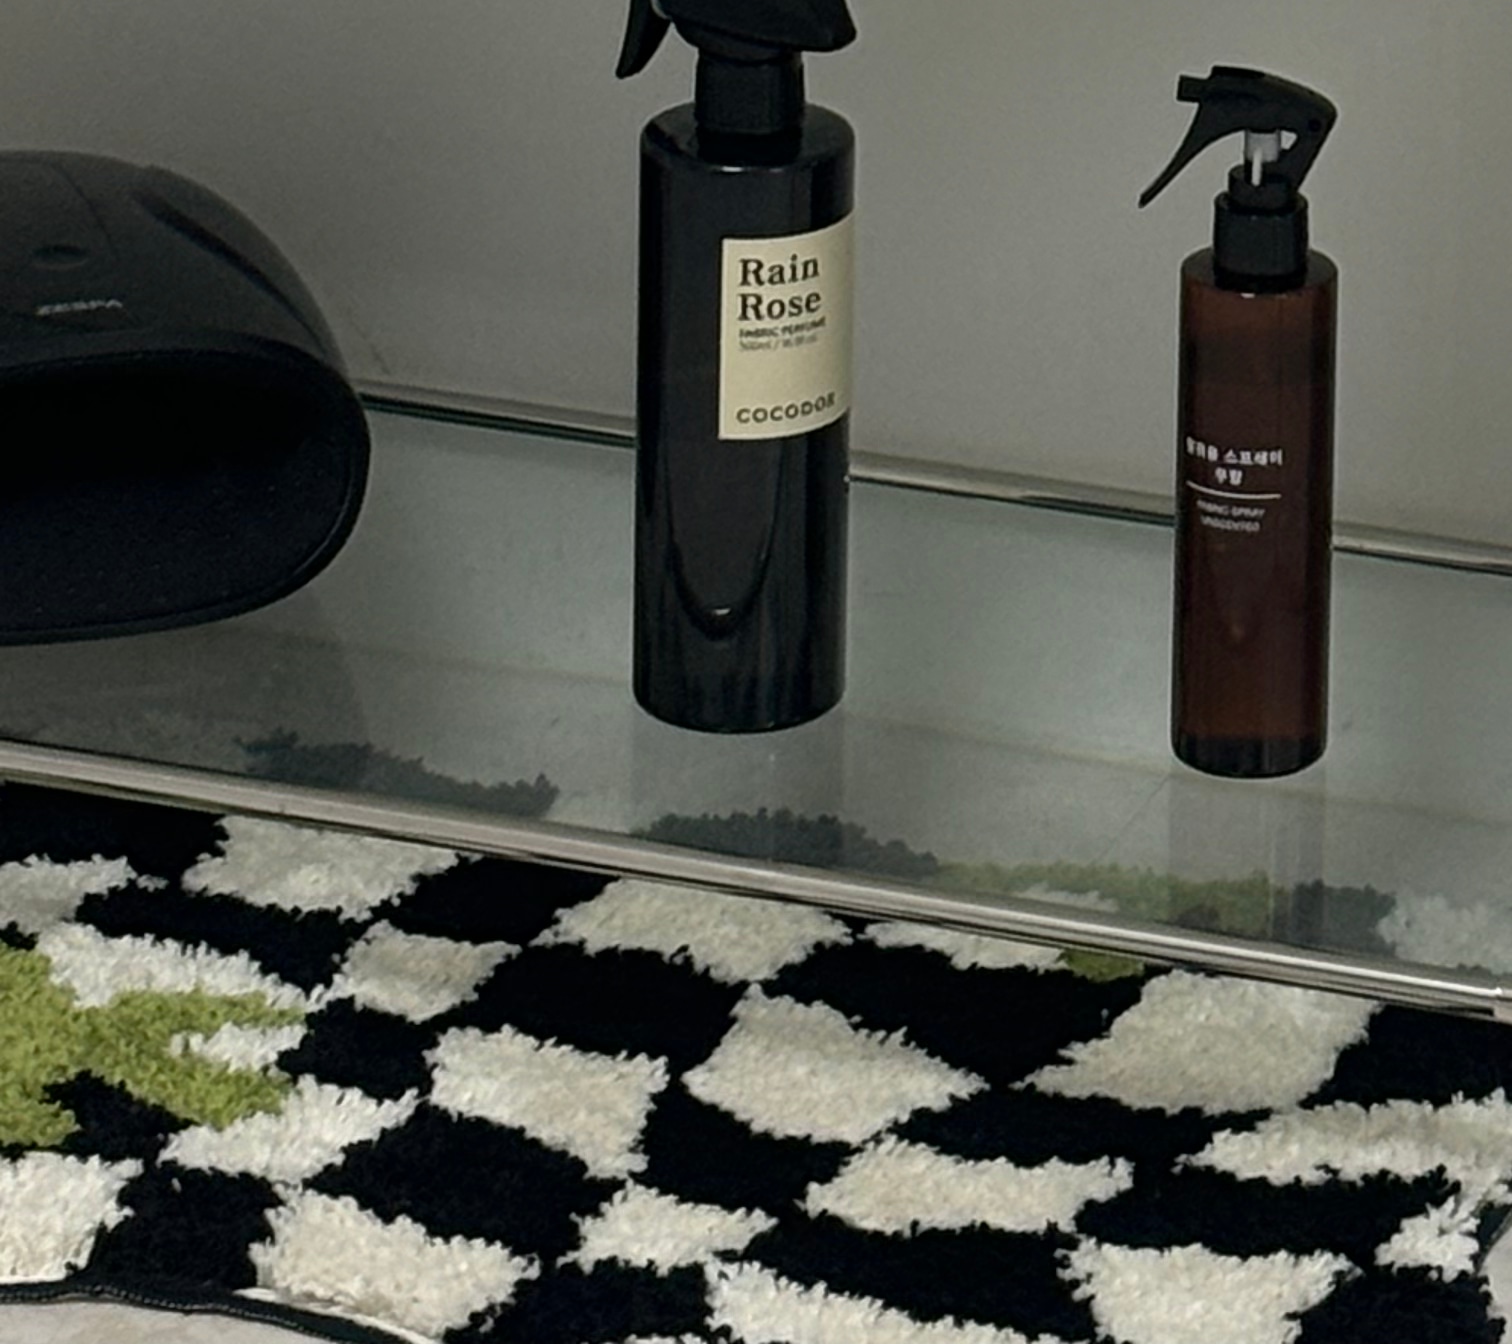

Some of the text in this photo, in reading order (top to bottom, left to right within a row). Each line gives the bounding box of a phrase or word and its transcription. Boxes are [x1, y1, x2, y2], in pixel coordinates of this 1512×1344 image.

[739, 253, 820, 287] Rain
[738, 291, 822, 321] Rose
[736, 392, 835, 424] COCODOR
